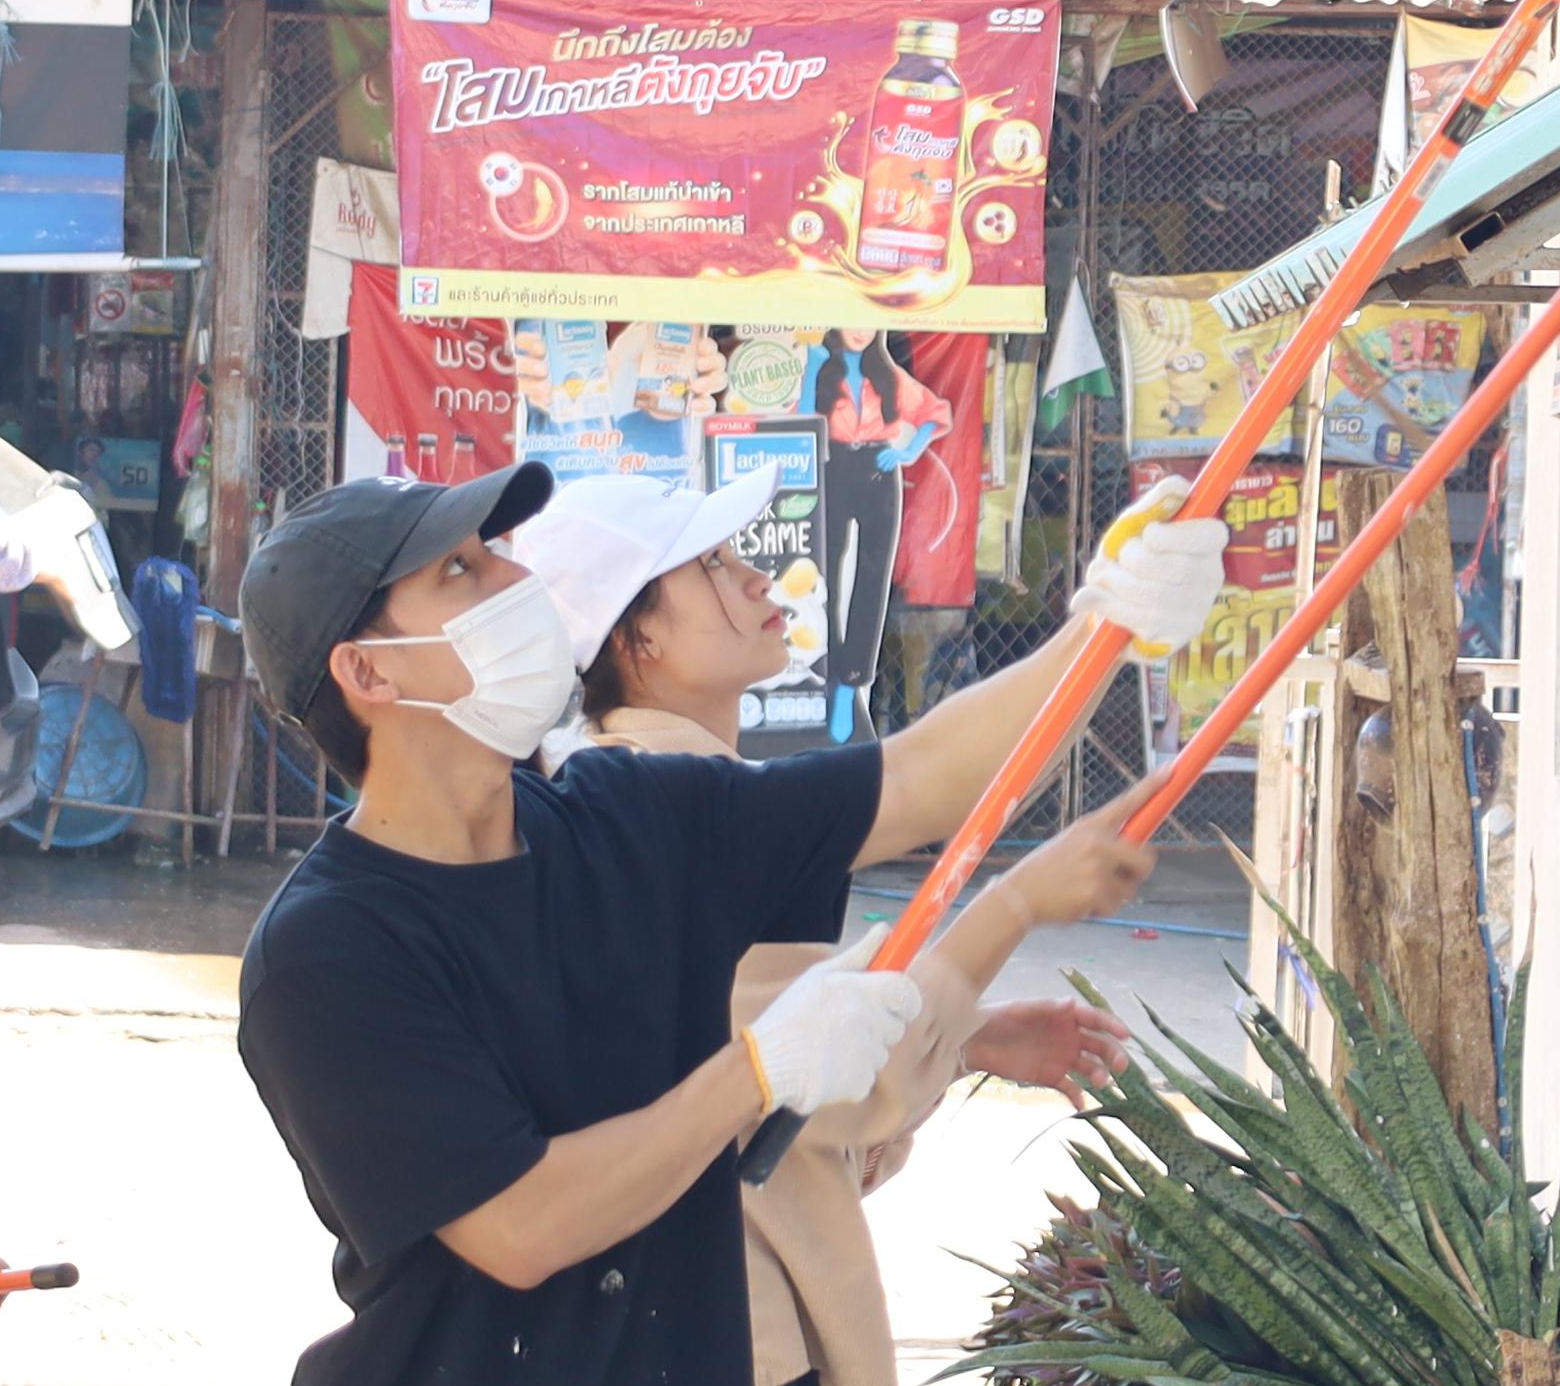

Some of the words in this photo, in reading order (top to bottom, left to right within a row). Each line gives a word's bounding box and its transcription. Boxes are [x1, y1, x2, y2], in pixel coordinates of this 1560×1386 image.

[989, 8, 1045, 25] GSD
[552, 17, 753, 61] นึกถึงโสมต้อง
[583, 180, 732, 203] รากโสมแท้นำเข้า
[583, 213, 746, 235] จากประเทศเกาหลี
[731, 367, 765, 390] PLANT
[766, 358, 803, 382] BASED
[435, 386, 519, 418] ทุกคว
[708, 422, 752, 431] SOYMILK
[1328, 418, 1362, 434] 160
[720, 442, 810, 483] Lactasoy
[730, 521, 812, 557] ESAME
